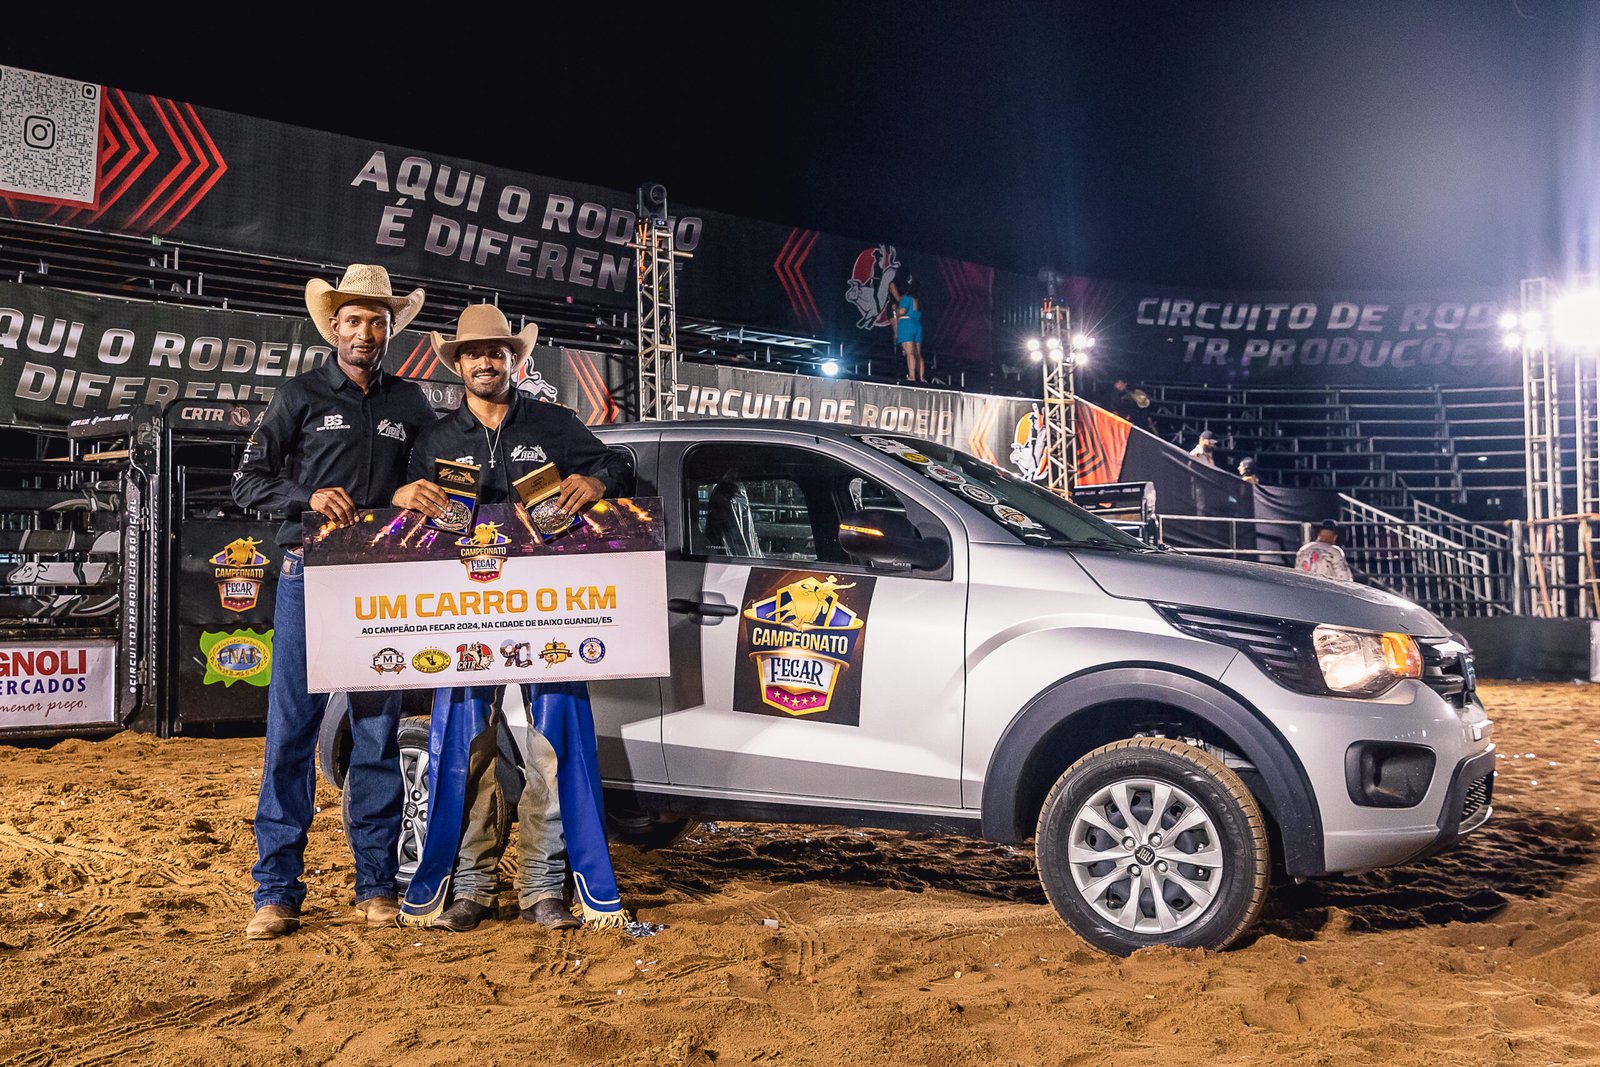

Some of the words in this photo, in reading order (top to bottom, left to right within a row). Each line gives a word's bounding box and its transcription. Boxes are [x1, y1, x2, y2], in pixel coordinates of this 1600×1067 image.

[351, 151, 486, 212] AQUI
[497, 185, 531, 223] O
[542, 194, 702, 251] RODO
[376, 198, 413, 247] É
[424, 214, 684, 297] DIFEREN
[1137, 298, 1317, 331] CIRCUITO
[1327, 302, 1389, 332] DE
[97, 328, 135, 364] O
[149, 331, 332, 376] RODEIO
[1182, 335, 1229, 365] TR
[181, 407, 225, 421] CRTR
[667, 384, 811, 420] CIRCUITO
[818, 398, 856, 424] DE
[861, 404, 954, 436] RODEIO
[461, 547, 507, 557] CAMPEONATO
[471, 559, 497, 571] FECAR
[215, 568, 263, 578] CAMPEONATO
[225, 583, 252, 596] FECAR
[355, 594, 408, 620] UM
[415, 589, 528, 618] CARRO
[565, 585, 616, 611] KM
[361, 627, 374, 635] AO
[375, 624, 415, 634] CAMPEÃO
[429, 623, 456, 632] FECAR
[456, 622, 480, 631] 2024,
[481, 621, 494, 629] NA
[494, 620, 525, 628] CIDADE
[525, 619, 537, 627] DE
[537, 618, 563, 627] BAIXO
[564, 616, 613, 625] GUANDU/ES
[752, 628, 849, 655] CAMPEONATO
[771, 657, 824, 687] FECAR
[0, 677, 87, 695] RCADOS
[45, 700, 88, 718] preço.
